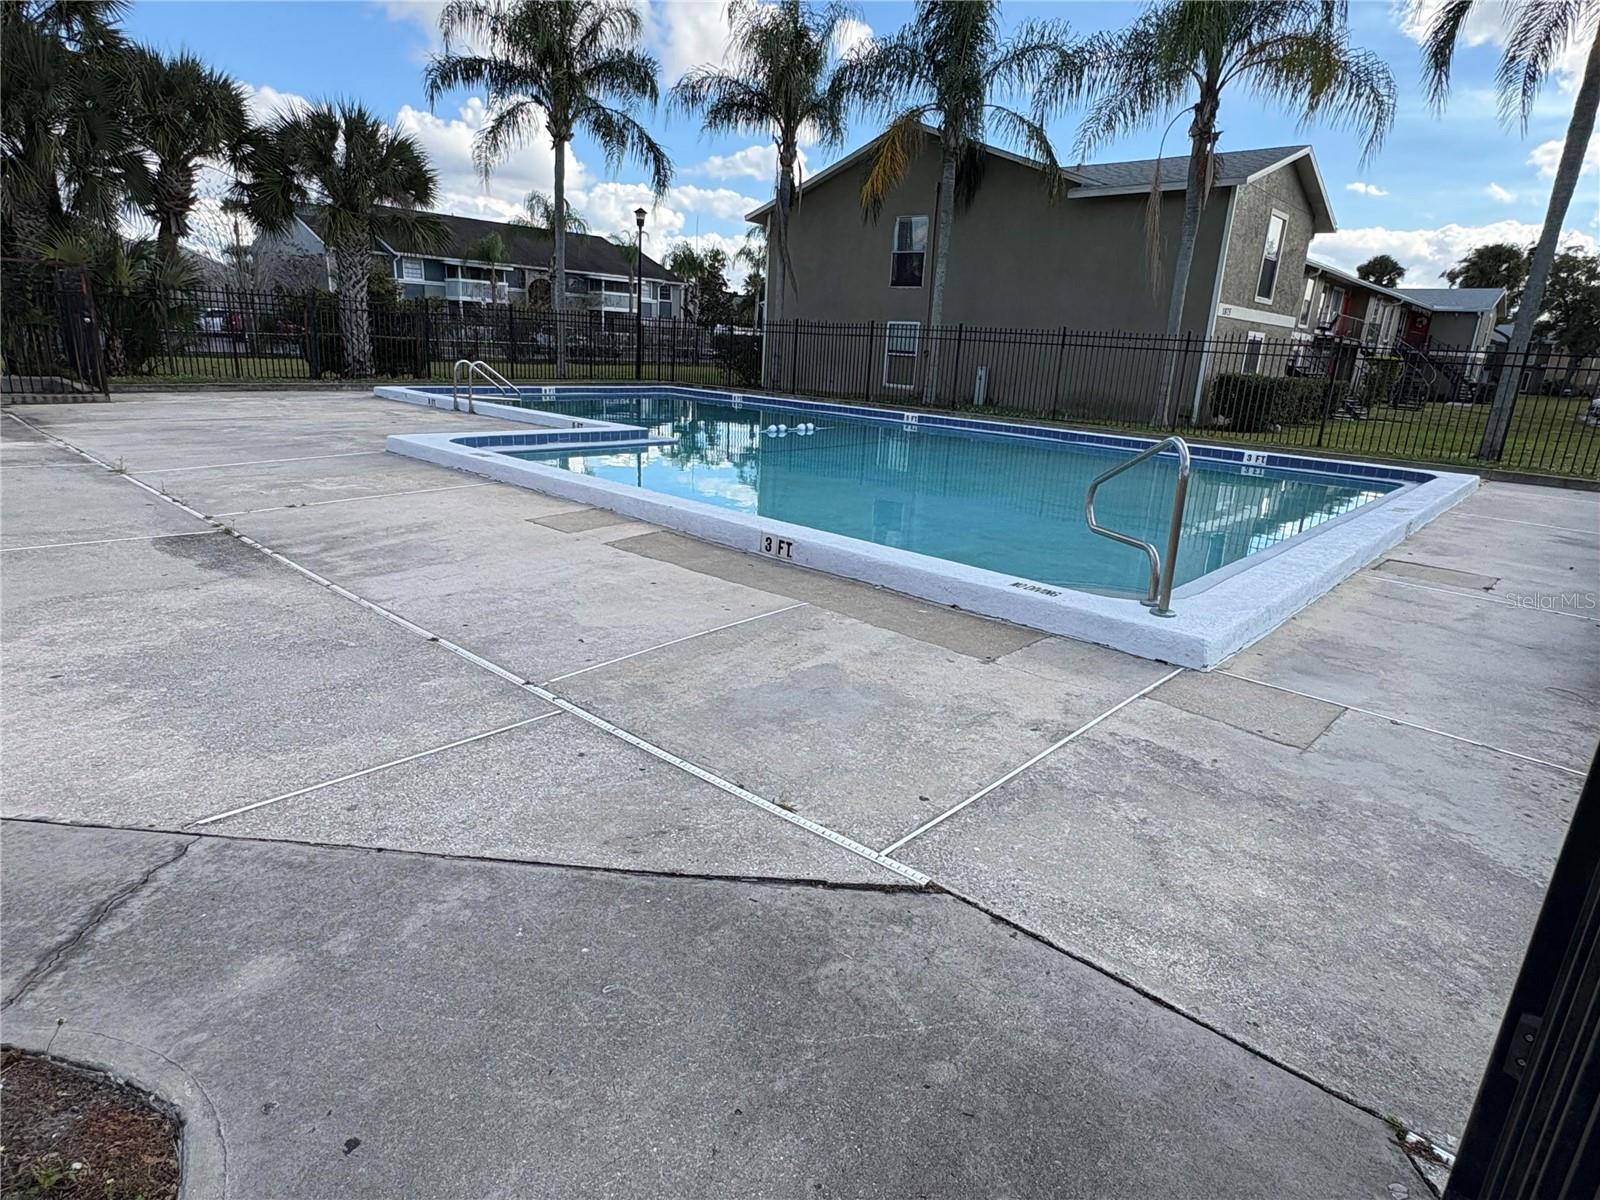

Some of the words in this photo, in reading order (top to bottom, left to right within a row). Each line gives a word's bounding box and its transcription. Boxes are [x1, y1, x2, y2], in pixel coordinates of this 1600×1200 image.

[1247, 454, 1252, 462] 3
[1255, 455, 1266, 463] FT
[765, 537, 772, 552] 3
